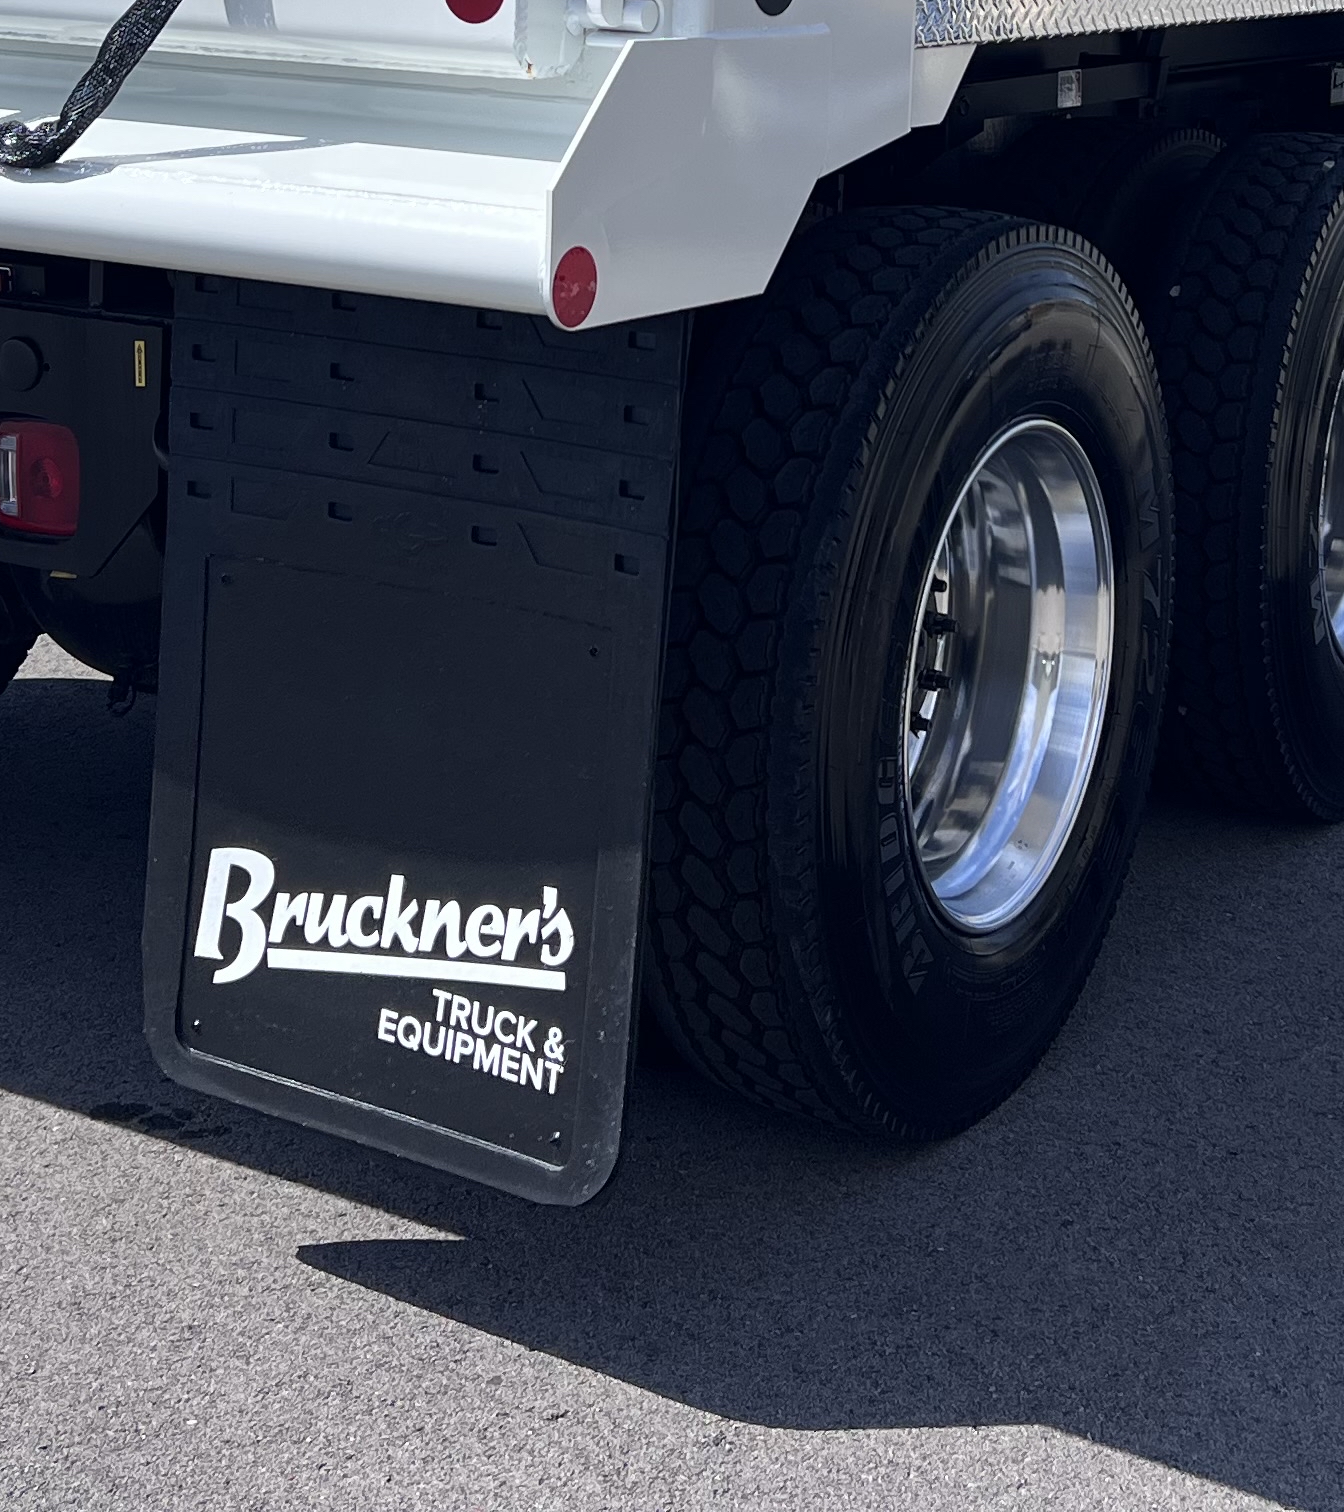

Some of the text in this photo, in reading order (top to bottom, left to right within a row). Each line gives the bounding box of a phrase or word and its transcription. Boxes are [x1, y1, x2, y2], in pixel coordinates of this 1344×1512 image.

[193, 847, 574, 984] Bruckner's
[377, 1008, 565, 1095] EQUIPMENT
[432, 988, 565, 1062] TRUCK &
